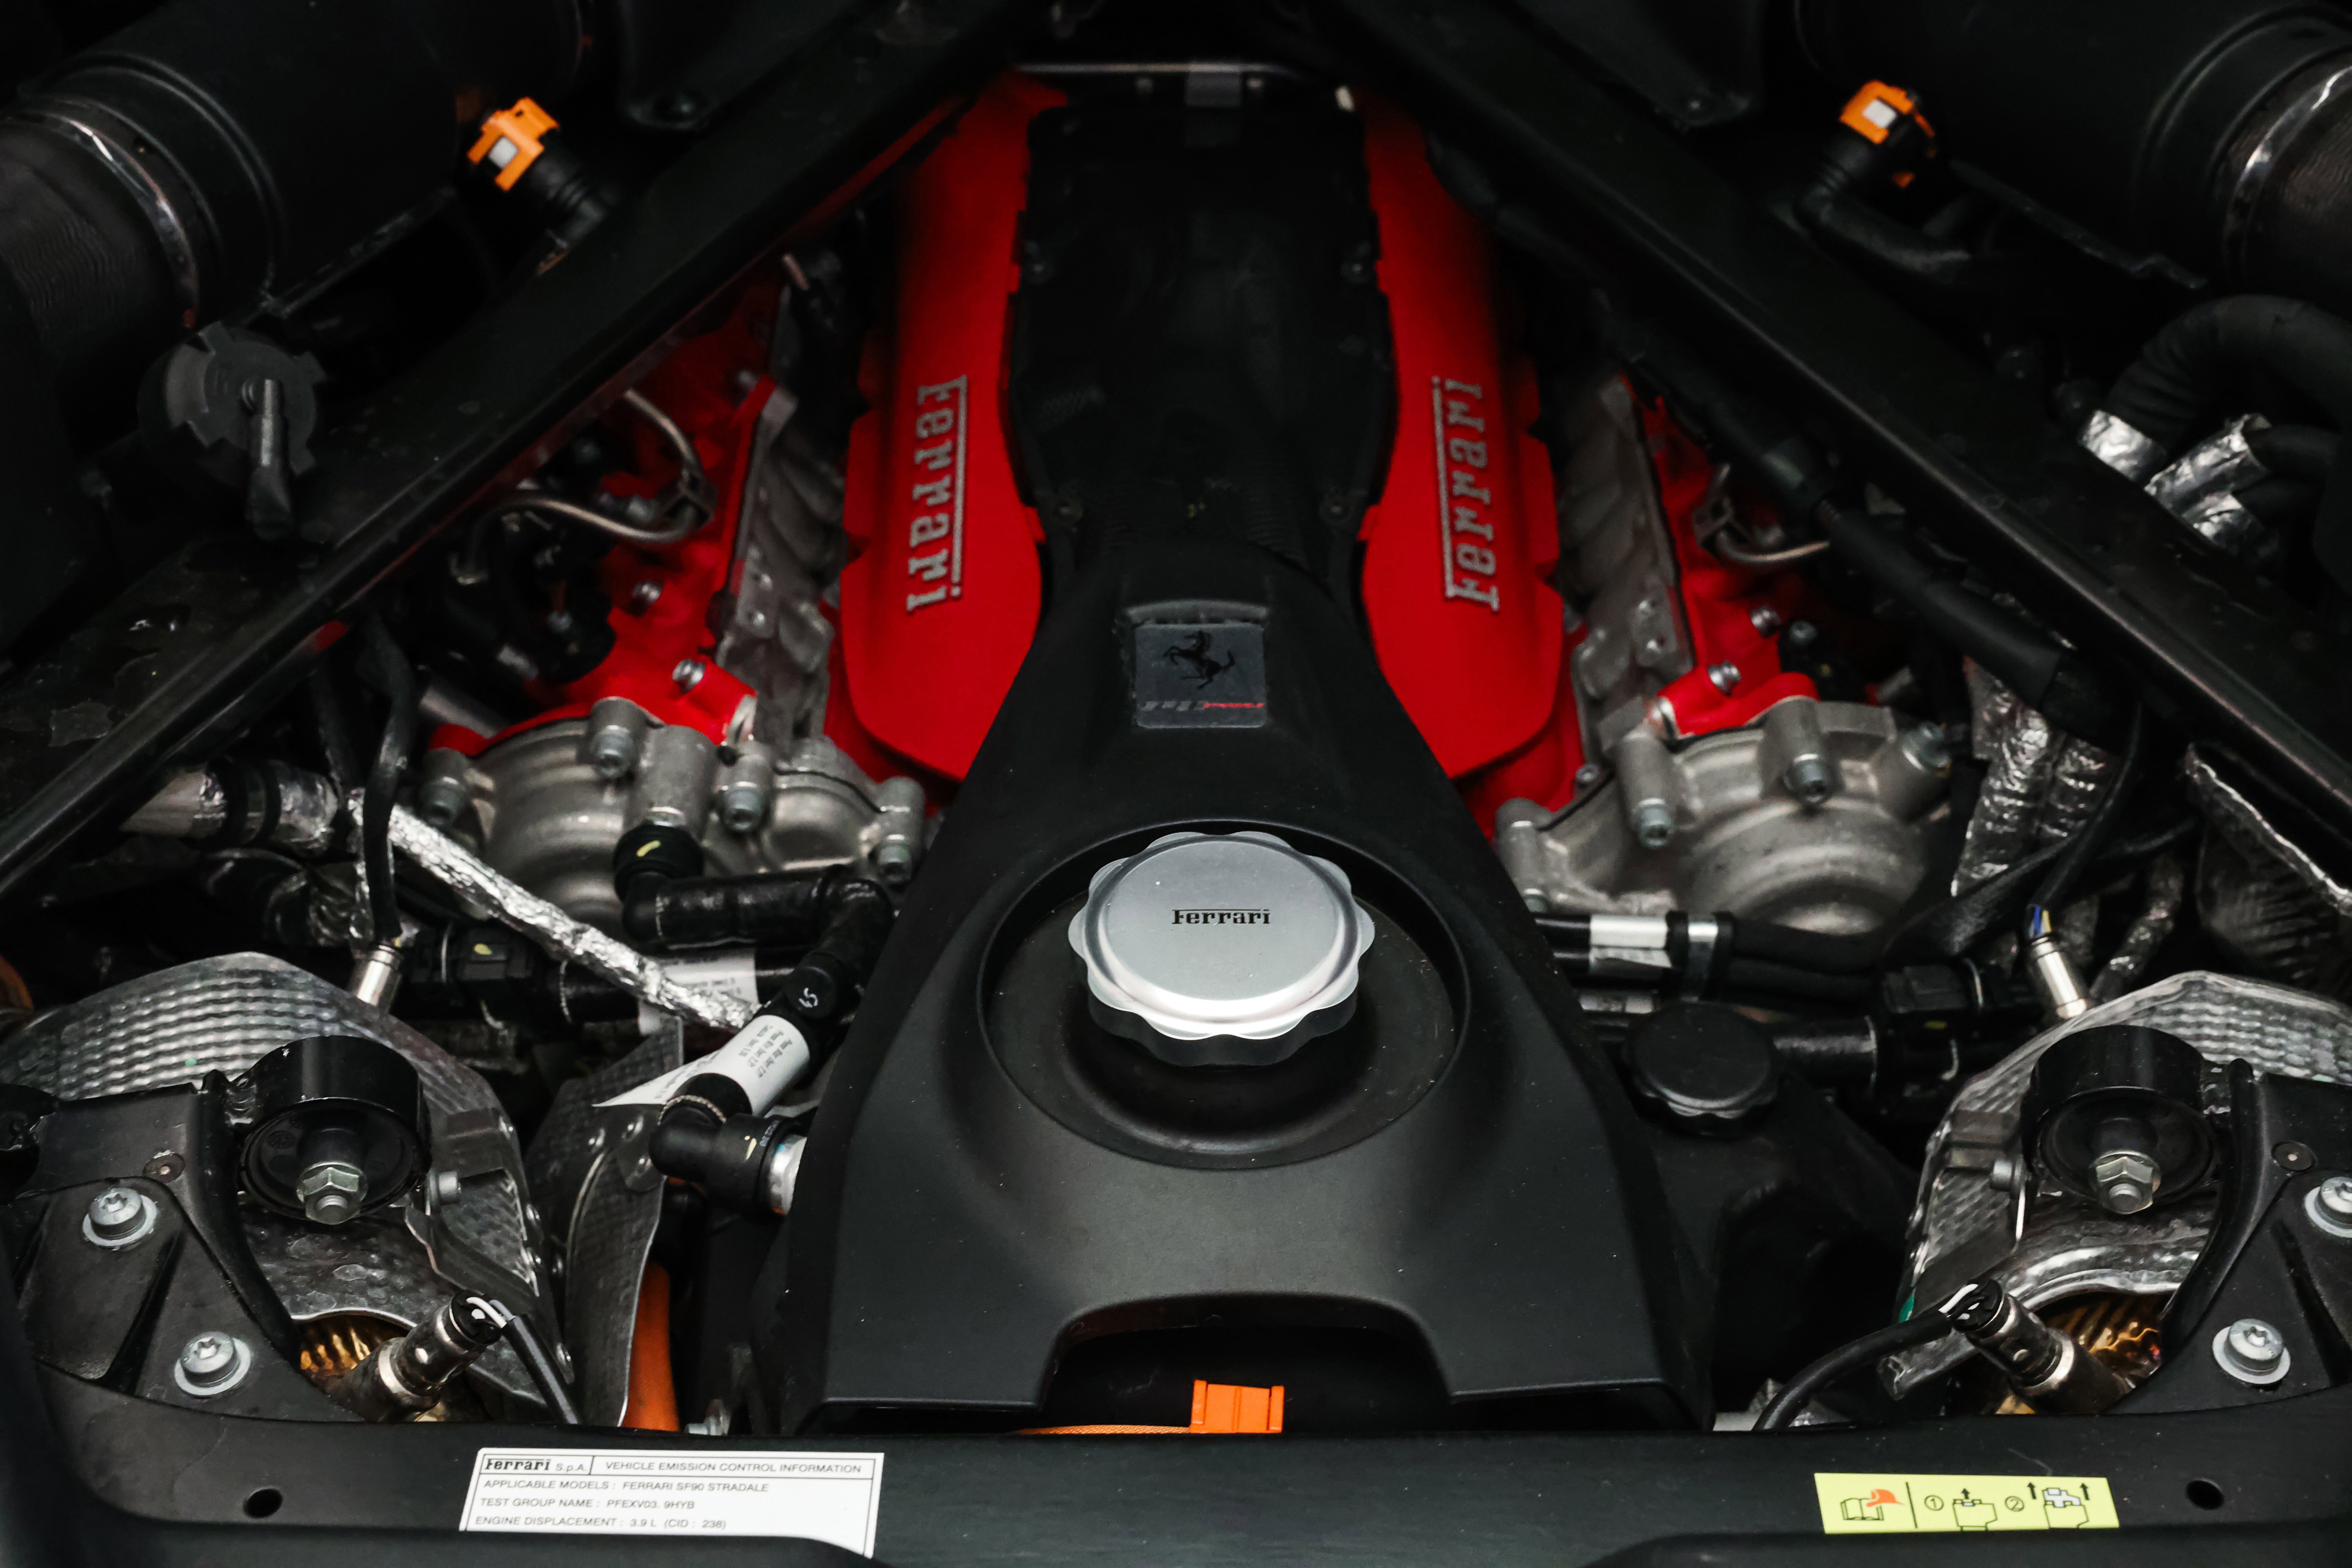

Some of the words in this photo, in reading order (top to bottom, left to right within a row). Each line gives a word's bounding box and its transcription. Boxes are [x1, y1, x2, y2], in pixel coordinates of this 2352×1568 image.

[906, 374, 968, 612] Ferrari
[1432, 376, 1499, 612] Ferrari
[1172, 909, 1271, 925] Ferrari
[485, 1459, 551, 1470] Ferrari
[606, 1462, 656, 1470] VEHICLE
[659, 1462, 716, 1471] EMISSION
[719, 1463, 776, 1471] CONTROL
[780, 1464, 861, 1473] INFORMATION
[484, 1480, 556, 1489] APPLICABLE
[559, 1481, 609, 1489] MODELS
[623, 1482, 673, 1490] FERRARI
[676, 1483, 704, 1491] SF90
[707, 1483, 768, 1492] STRADALE
[480, 1498, 510, 1506] TEST
[512, 1498, 556, 1507] GROUP
[559, 1499, 593, 1507] NAME
[475, 1516, 521, 1525] ENGINE
[524, 1517, 617, 1526] DISPLACEMENT
[630, 1519, 647, 1527] 3.9
[650, 1519, 657, 1527] L
